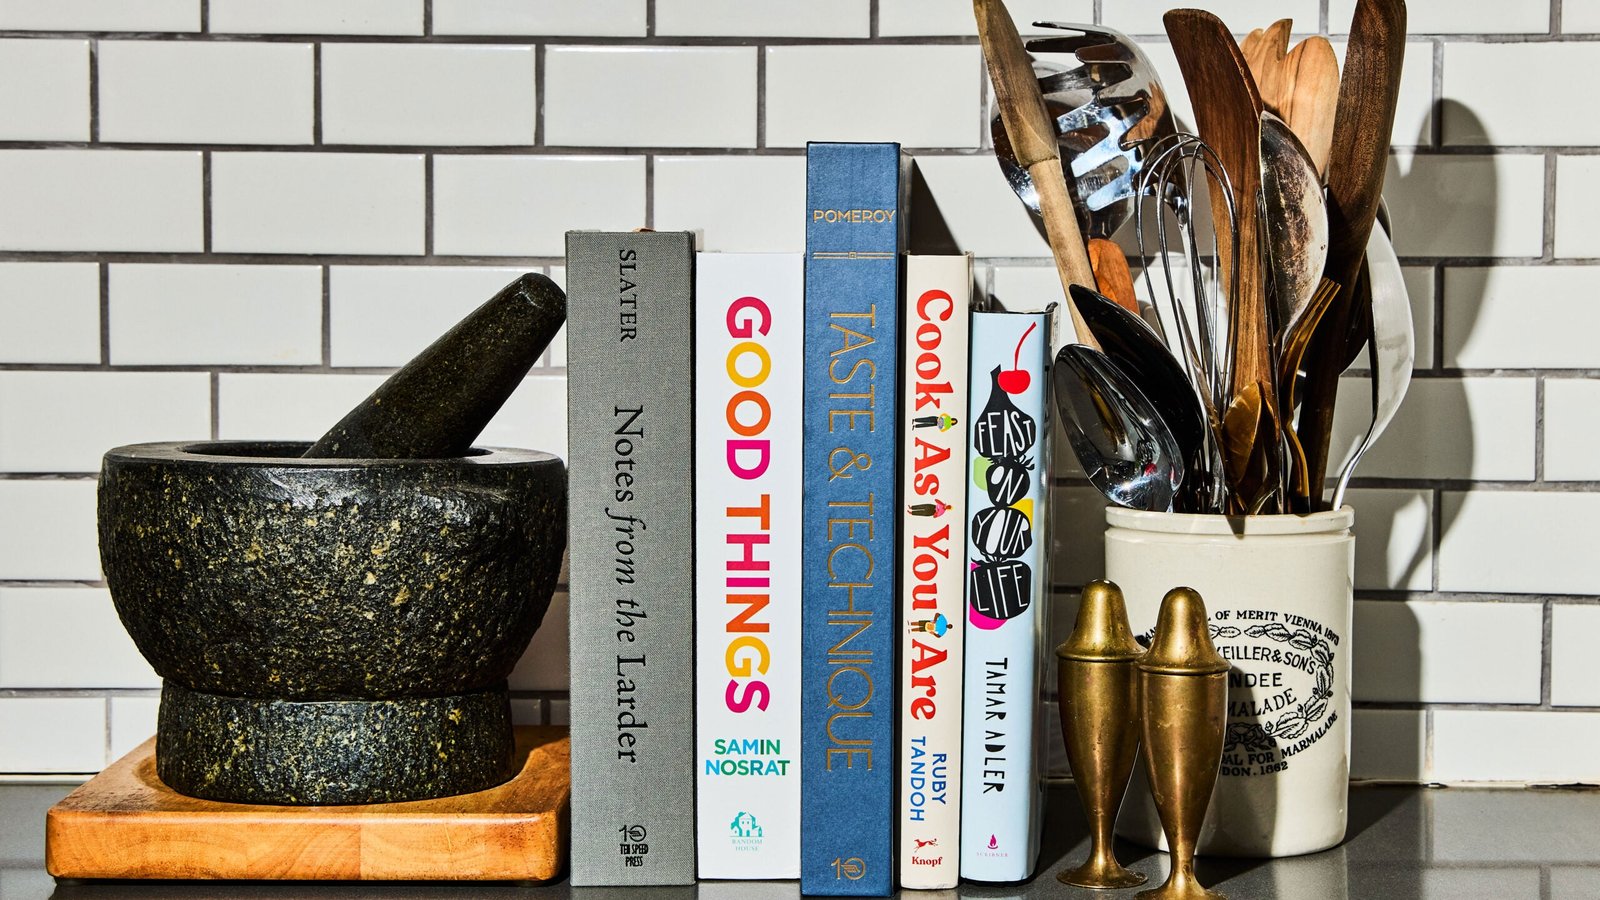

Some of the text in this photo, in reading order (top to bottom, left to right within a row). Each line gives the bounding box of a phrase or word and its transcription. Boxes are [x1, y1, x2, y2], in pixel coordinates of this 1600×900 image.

[813, 209, 896, 224] POMEROY
[619, 249, 637, 342] SLATER
[978, 409, 1032, 458] FEAST
[725, 296, 771, 713] GOOD THINGS
[911, 290, 953, 719] Cook As You Are
[991, 465, 1024, 505] ON
[826, 303, 877, 772] TASTE & TECHNIQUE
[976, 509, 1030, 555] YOUR
[605, 405, 648, 763] Notes from the Larder
[972, 564, 1029, 619] LIFE
[1215, 610, 1231, 620] OF
[1236, 610, 1278, 621] MERIT
[1284, 613, 1322, 635] VIENNA
[1227, 688, 1297, 717] MALADE
[1228, 672, 1283, 688] NDEE
[715, 739, 780, 755] SAMIN
[984, 658, 1007, 793] TAMAR ADLER
[1248, 752, 1275, 765] FOR
[1281, 711, 1338, 759] MARMALADE
[706, 760, 790, 775] NOSRAT
[910, 736, 925, 821] TANDOH
[932, 754, 947, 804] RUBY
[1260, 761, 1288, 776] 1862
[625, 855, 643, 867] PRESS
[632, 844, 649, 855] SPEED
[911, 855, 943, 868] Knopf
